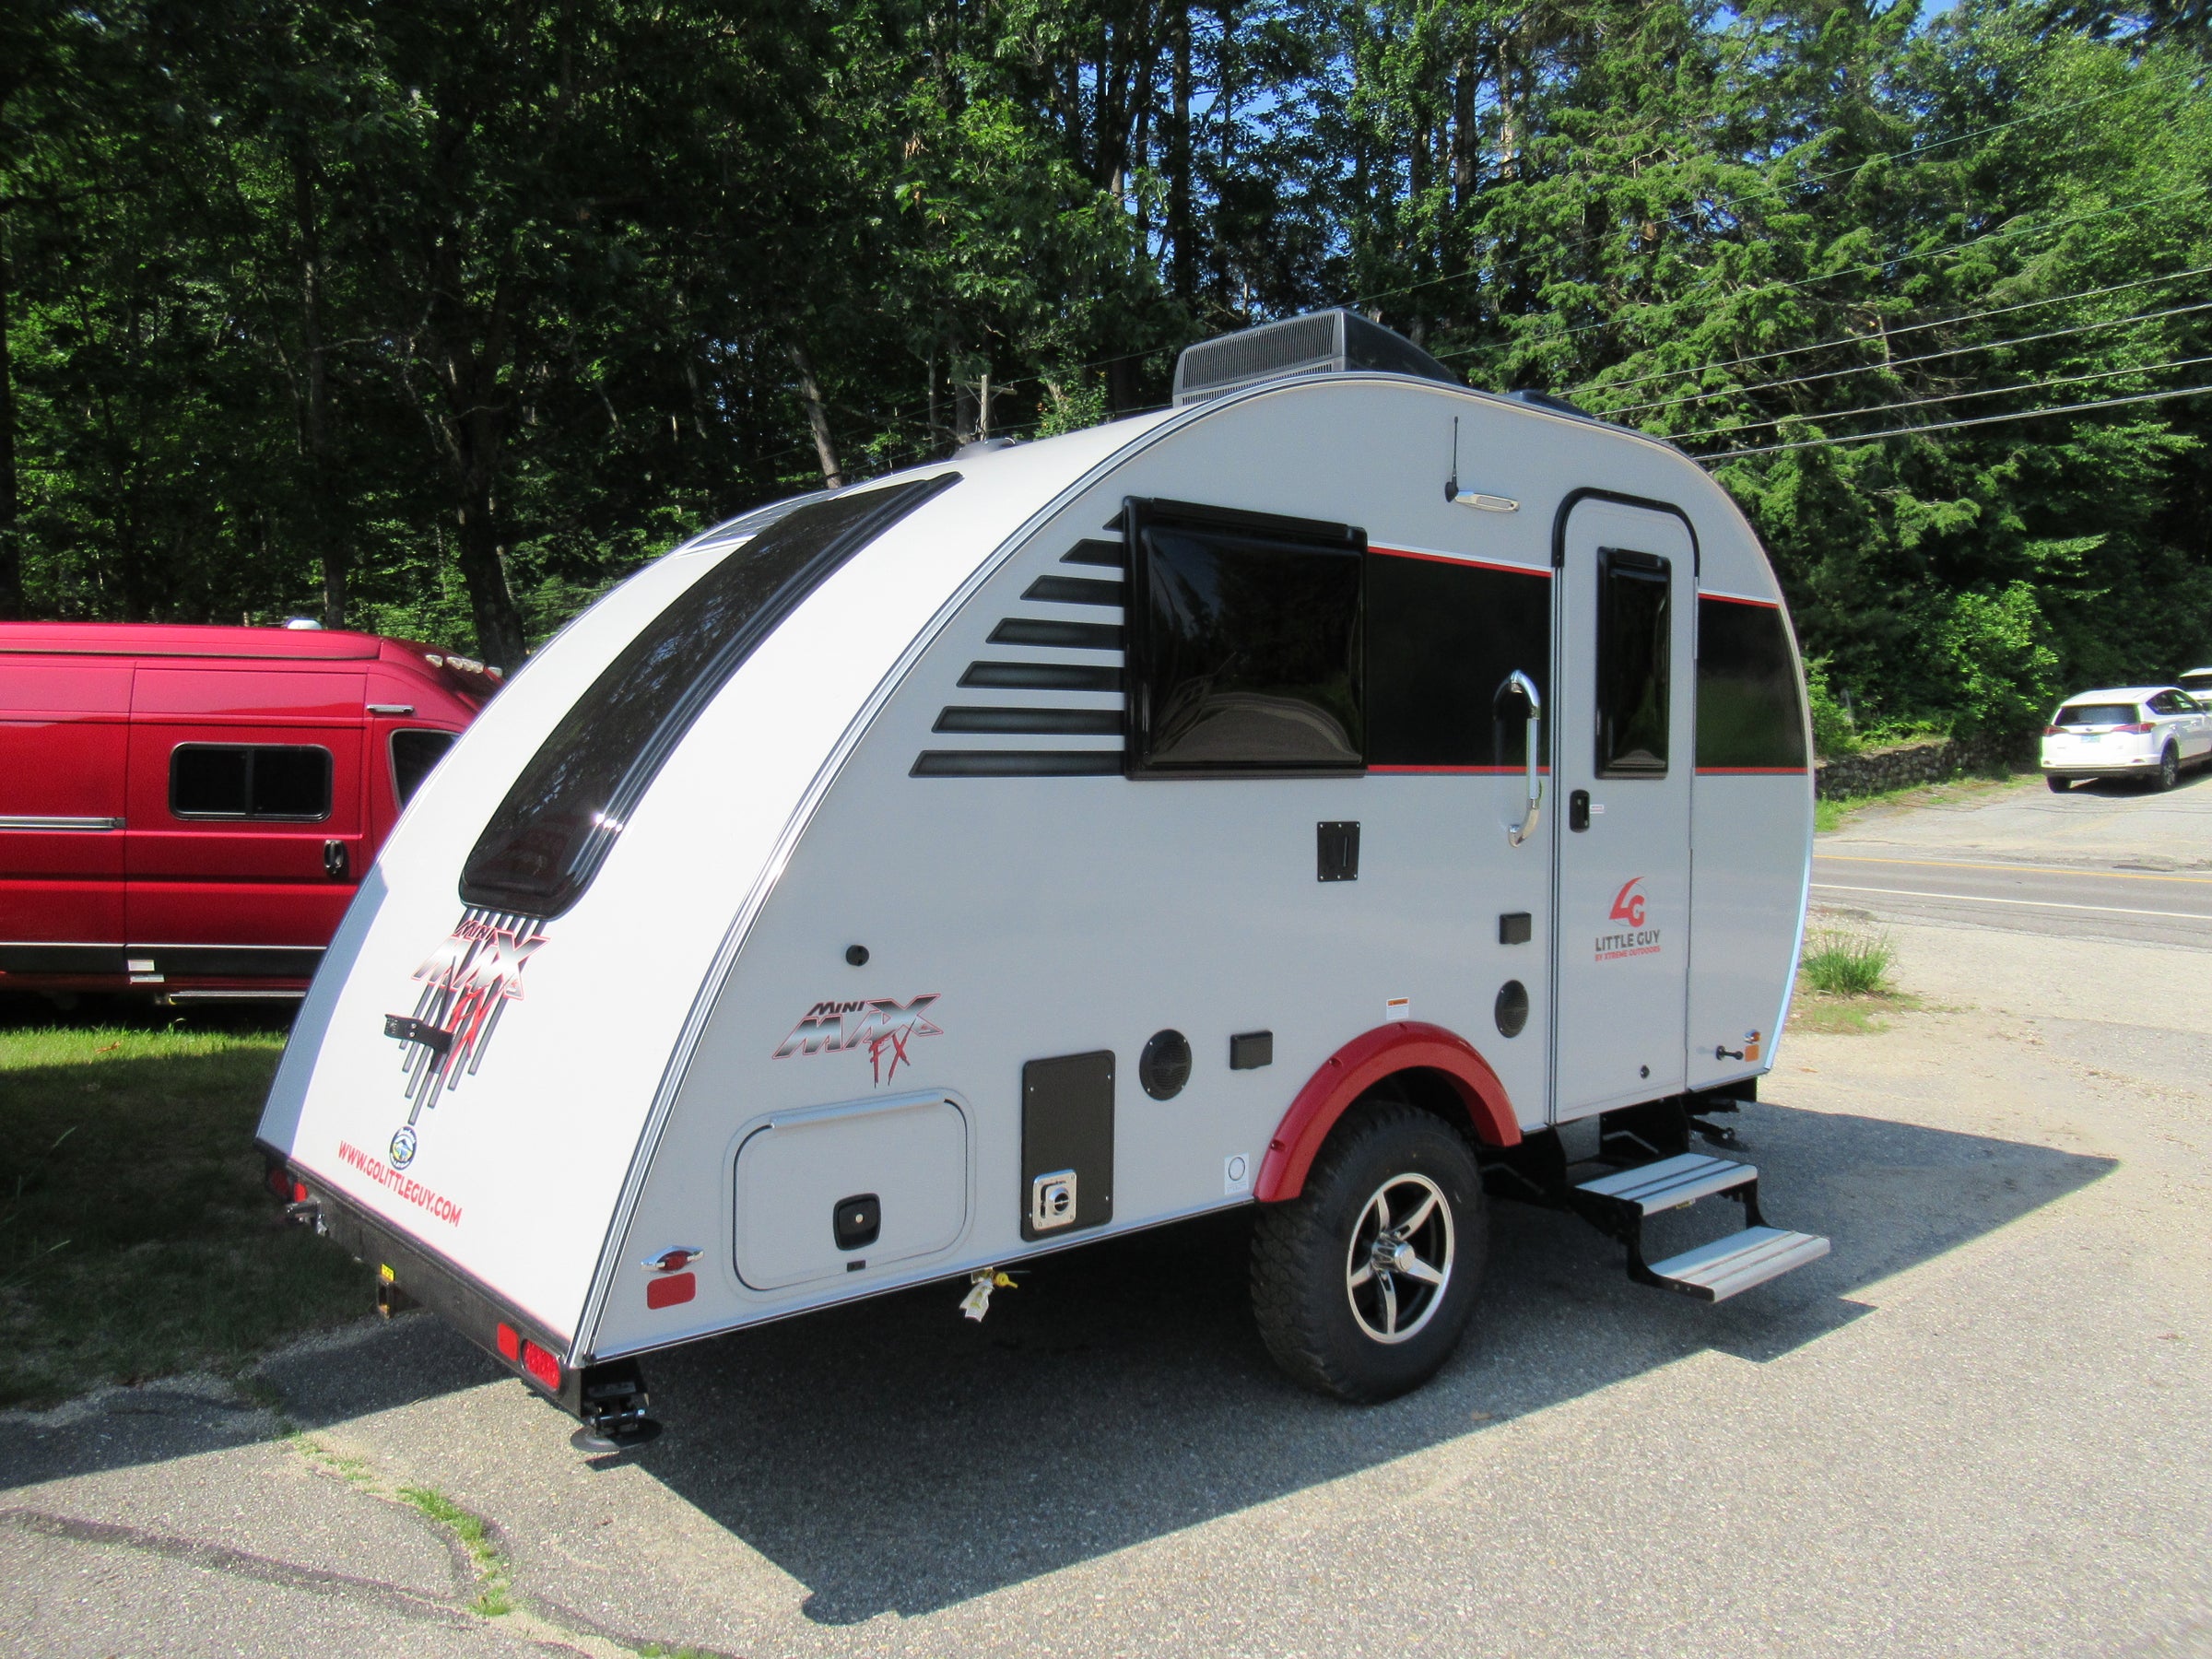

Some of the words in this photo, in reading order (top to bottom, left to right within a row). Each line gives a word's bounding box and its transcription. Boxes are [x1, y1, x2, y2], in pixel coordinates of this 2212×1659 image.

[411, 929, 551, 1000] MAX
[1595, 933, 1634, 952] LITTLE
[1636, 929, 1661, 946] GUY
[771, 993, 944, 1060] MAX
[805, 1001, 866, 1017] MINI
[868, 1018, 916, 1088] FX
[337, 1140, 463, 1228] WWW.GOLITTLEGUY.COM
